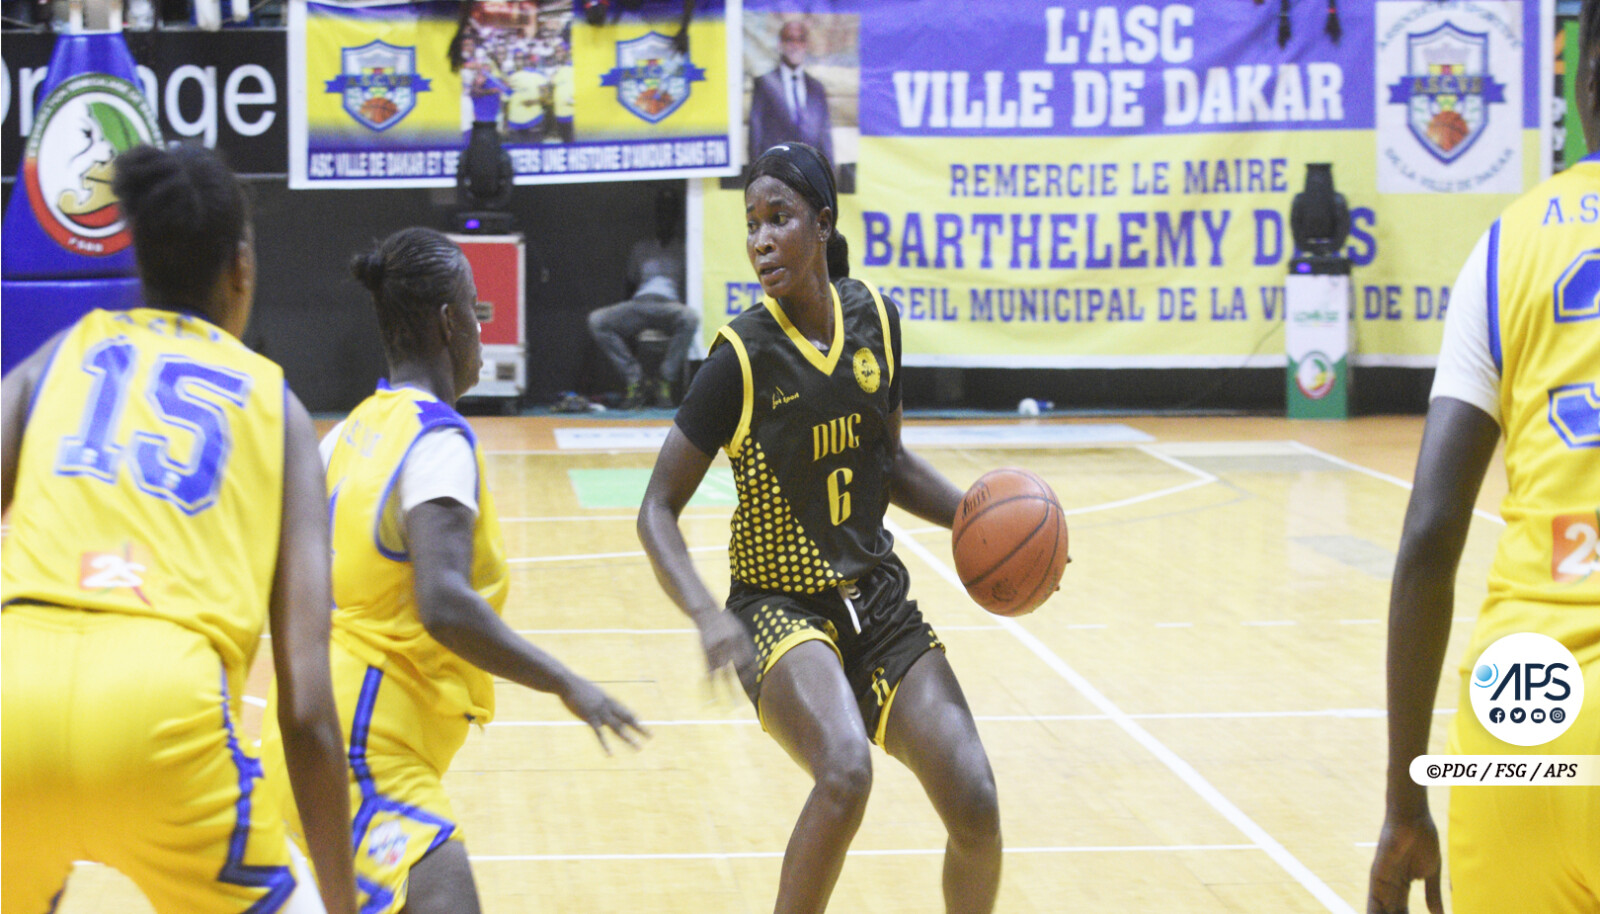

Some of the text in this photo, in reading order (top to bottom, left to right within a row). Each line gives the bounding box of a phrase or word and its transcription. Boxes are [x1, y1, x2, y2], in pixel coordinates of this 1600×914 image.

[1045, 4, 1194, 64] L'ASC
[893, 61, 1344, 129] VILLE DE DAKAR
[310, 139, 729, 177] ASC VILLE DE DAKAR ET SE TERS UNE HISTOIRE D'AMOUR SANS FIN
[950, 158, 1288, 198] REMERCIE LE MAIRE
[862, 207, 1377, 270] BARTHELEMY DS
[725, 282, 763, 315] ET
[879, 286, 959, 322] SEIL
[970, 287, 1145, 323] MUNICIPAL
[1158, 286, 1197, 322] DE
[1211, 286, 1248, 322] LA
[1364, 285, 1402, 321] DE
[1415, 285, 1452, 321] DA
[56, 335, 251, 517] 15
[813, 412, 862, 461] DUC
[827, 467, 854, 526] 6
